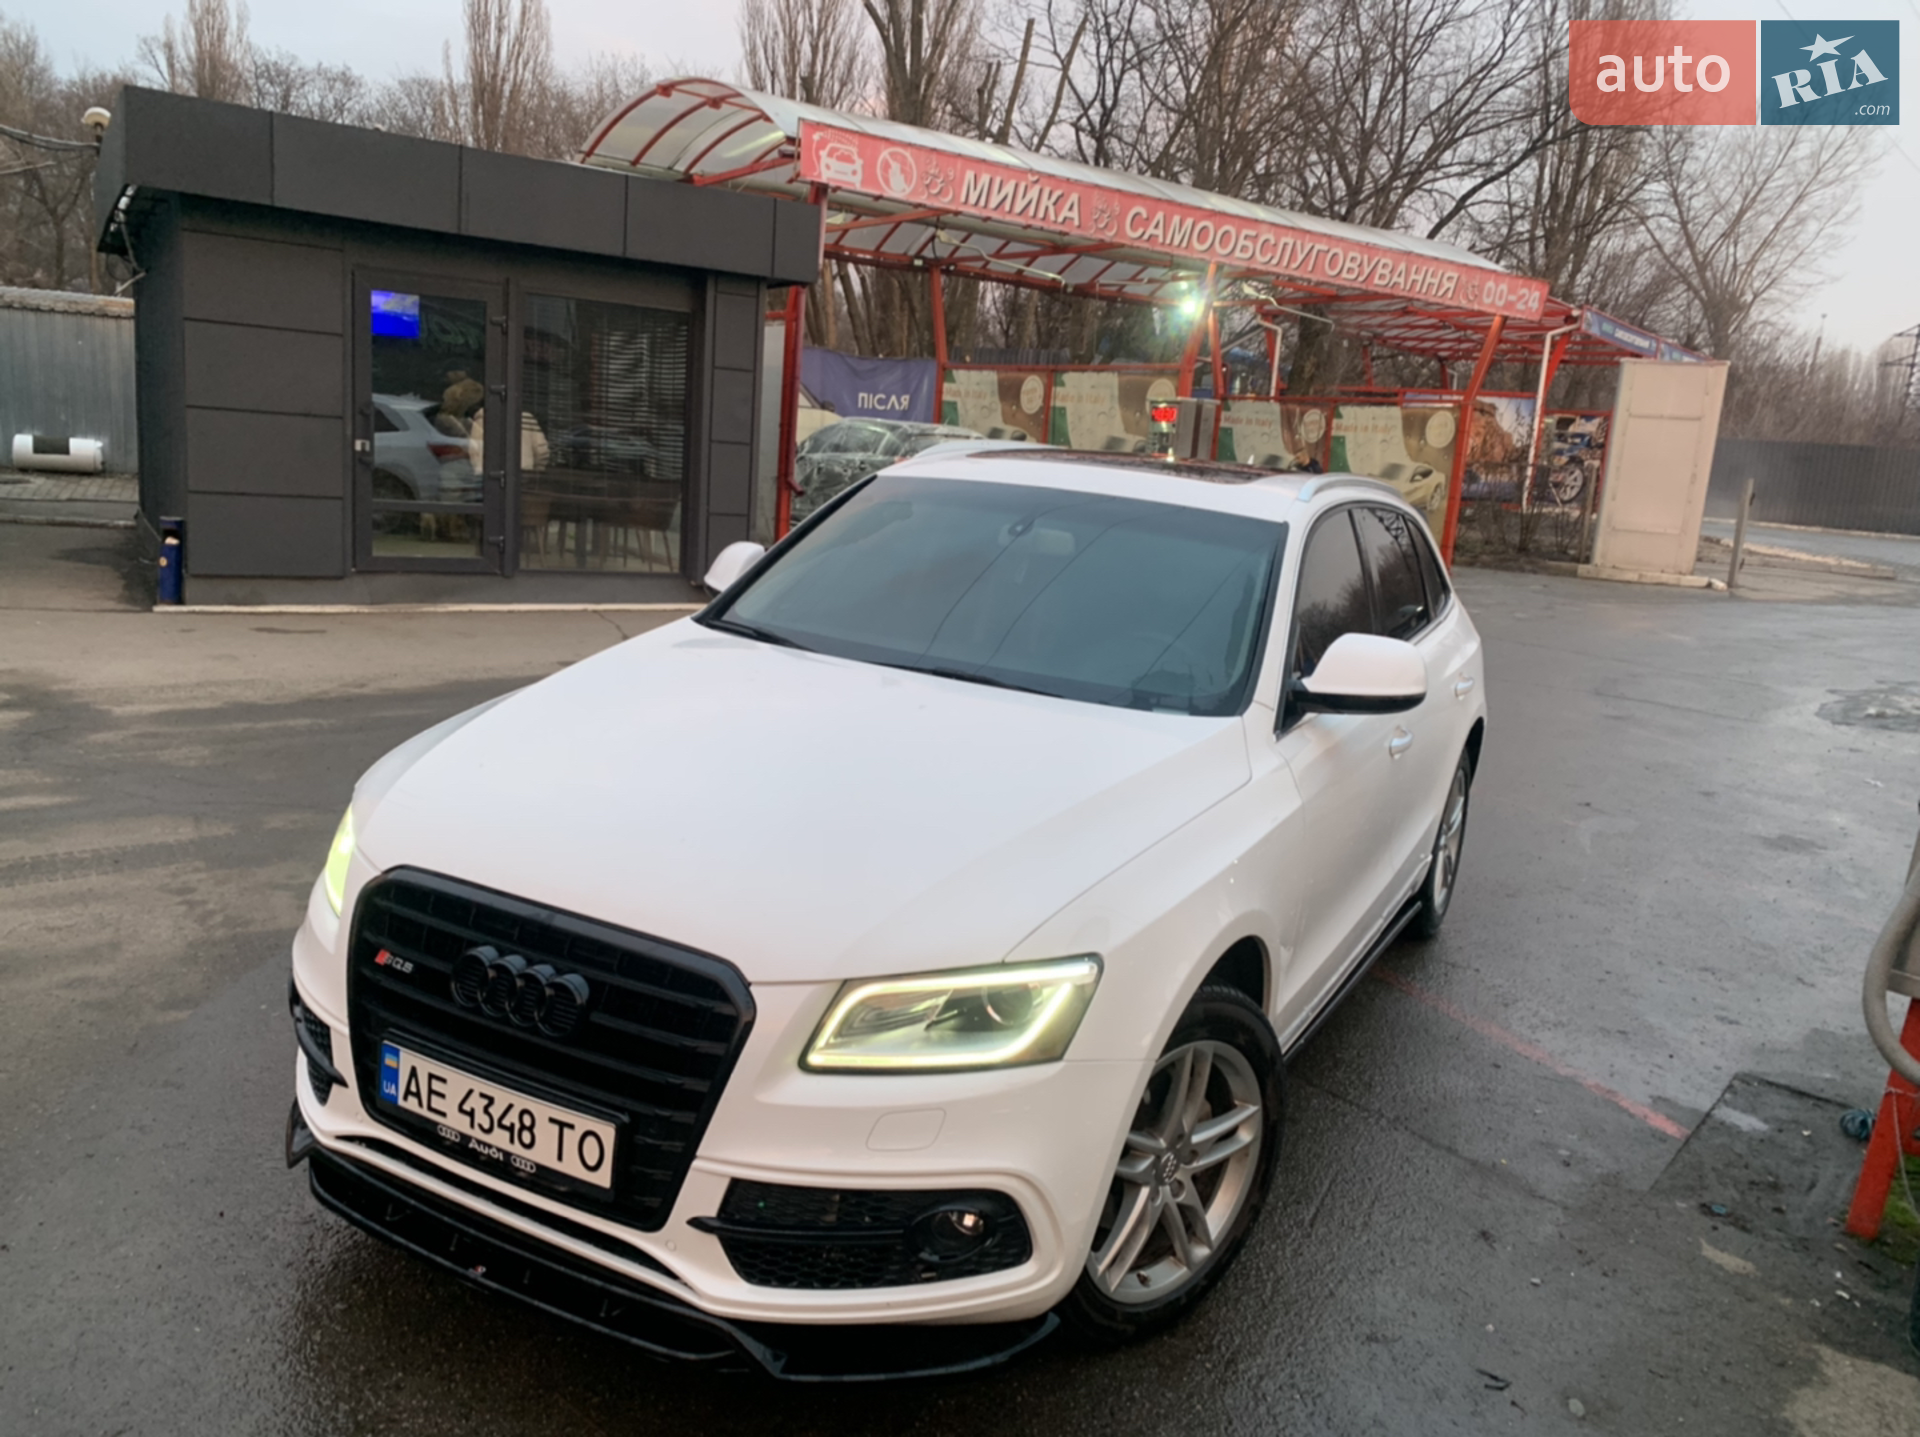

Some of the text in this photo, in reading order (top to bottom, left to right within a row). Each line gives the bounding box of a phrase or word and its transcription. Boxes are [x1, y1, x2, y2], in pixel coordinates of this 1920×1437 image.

[960, 169, 1541, 313] МИЙКА САМООБСЛУГОВУВАННЯ 00-24
[857, 391, 911, 412] ПІСЛЯ
[1223, 413, 1244, 425] Made
[1335, 422, 1357, 433] Made
[382, 1079, 398, 1097] UA
[402, 1065, 606, 1172] AE 4348 TO
[468, 1138, 504, 1161] Audi
